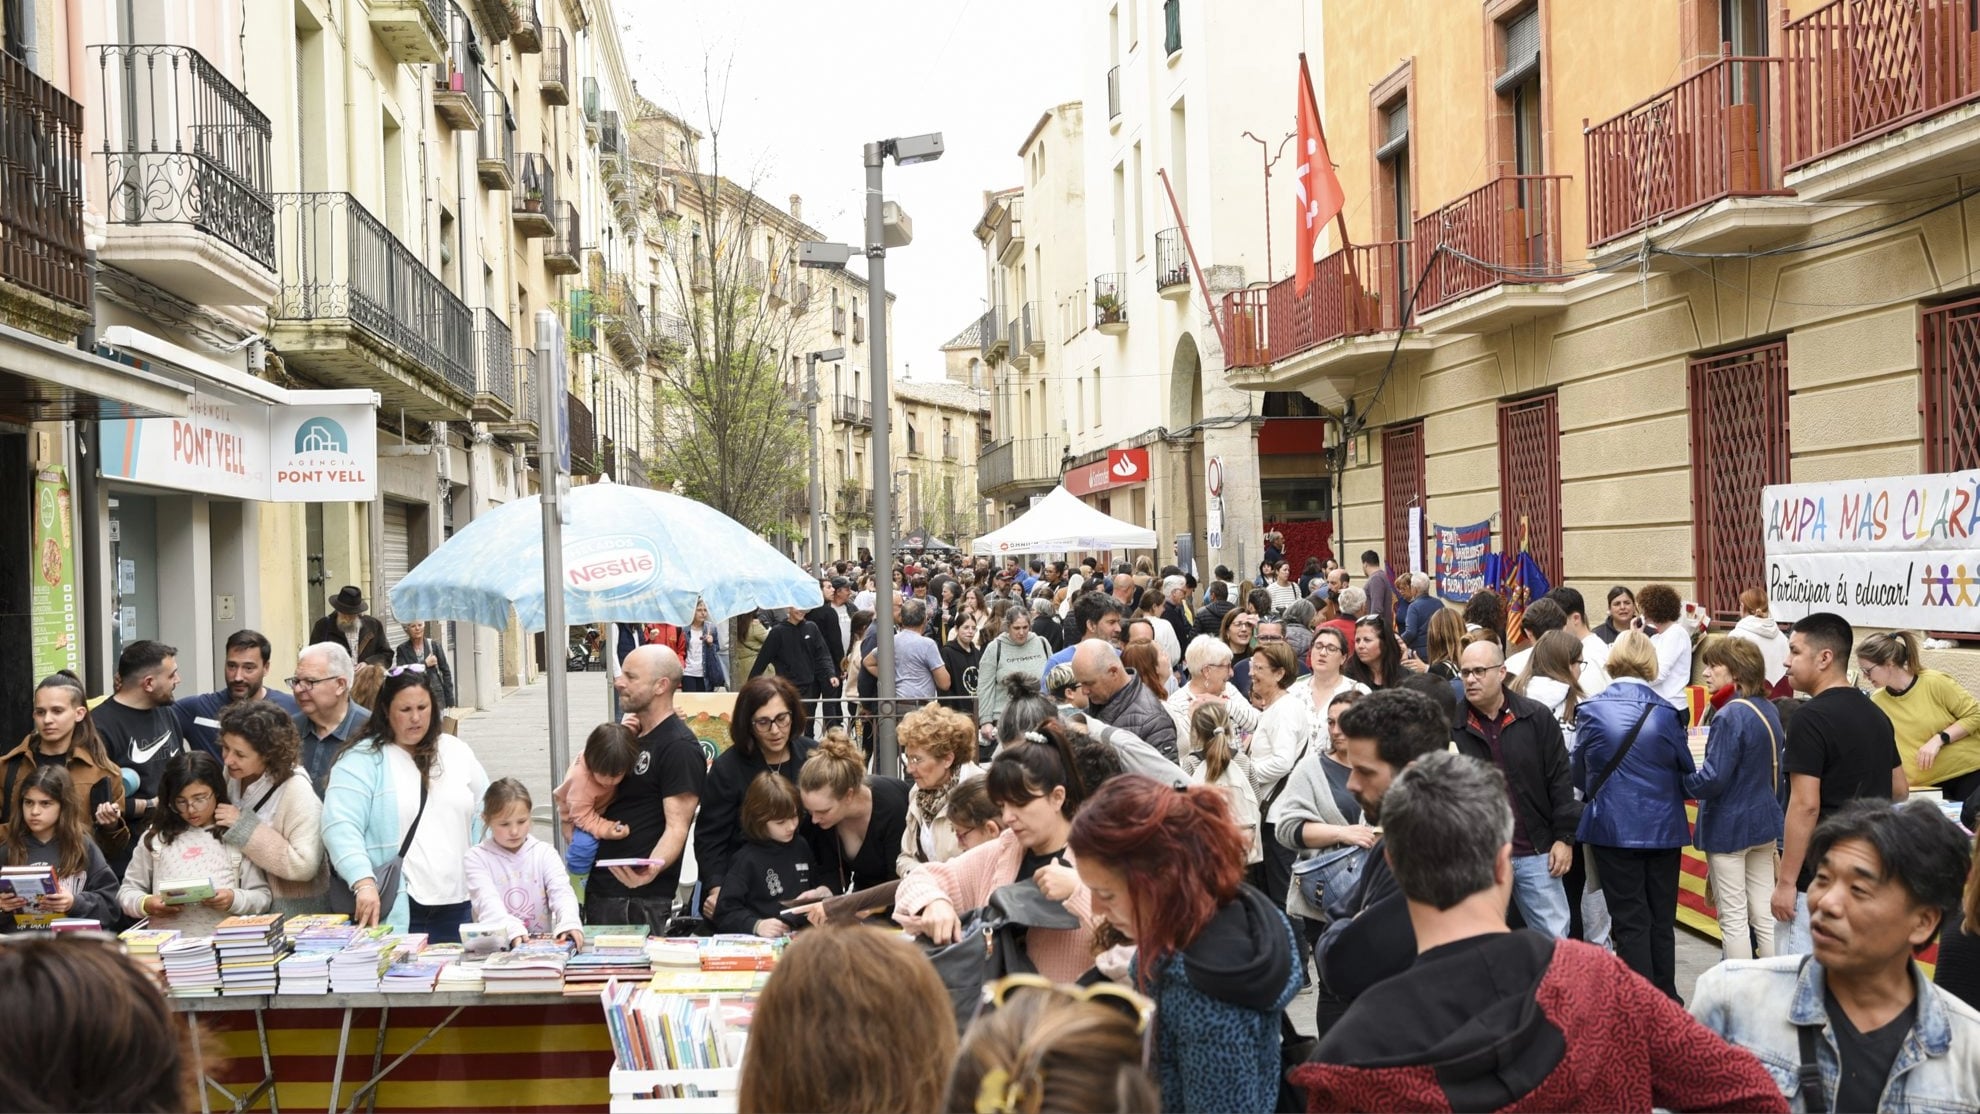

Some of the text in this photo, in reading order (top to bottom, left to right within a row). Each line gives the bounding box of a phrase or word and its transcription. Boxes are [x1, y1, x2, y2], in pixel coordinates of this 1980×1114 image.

[173, 419, 245, 475] PONT VELL
[288, 458, 356, 466] AGÈNCIA
[277, 470, 323, 483] PONT
[326, 470, 366, 483] VELL
[1767, 496, 1828, 543] AMPA
[1839, 489, 1889, 542] MAS
[569, 554, 654, 585] Nestlé
[1770, 561, 1914, 613] Participar és educar!
